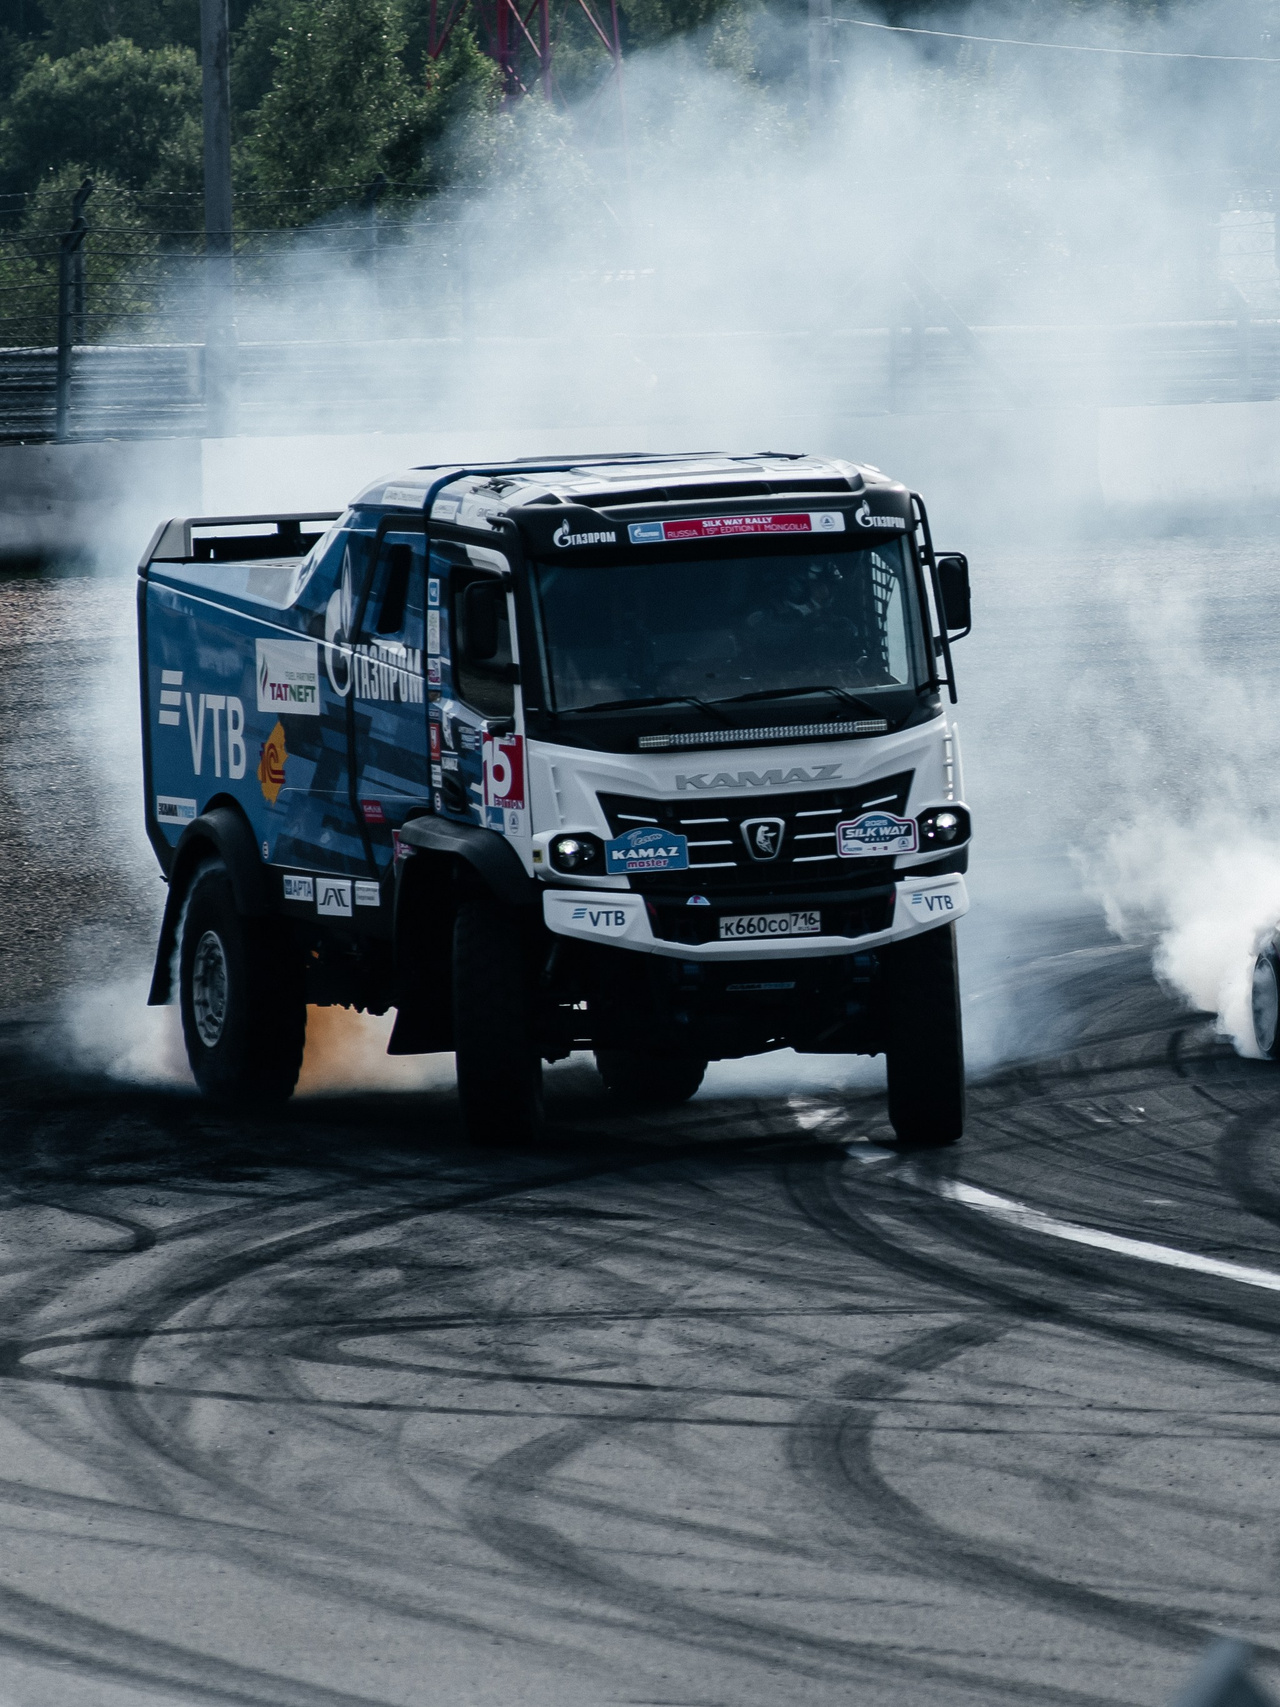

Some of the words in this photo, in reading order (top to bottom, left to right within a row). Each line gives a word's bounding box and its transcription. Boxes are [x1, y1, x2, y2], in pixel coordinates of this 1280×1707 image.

[702, 519, 722, 528] SILK
[724, 518, 743, 526] WAY
[745, 517, 772, 525] RALLY
[570, 531, 616, 545] ГАЗПРОМ
[667, 529, 698, 539] RUSSIA
[721, 525, 754, 534] EDITION
[764, 523, 809, 531] MONGOLIA
[354, 644, 424, 703] ГАЗПРОМ
[269, 683, 316, 703] TATNEFT
[185, 692, 246, 779] VTB
[675, 763, 843, 790] KAMAZ
[494, 798, 523, 809] EDITION
[865, 819, 888, 827] 2025
[628, 831, 662, 847] Team
[845, 827, 877, 838] SILK
[880, 825, 908, 836] WAY
[612, 847, 680, 860] KAMAZ
[627, 858, 668, 869] master
[924, 895, 954, 911] VTB
[588, 910, 626, 927] VTB
[791, 913, 816, 927] 716
